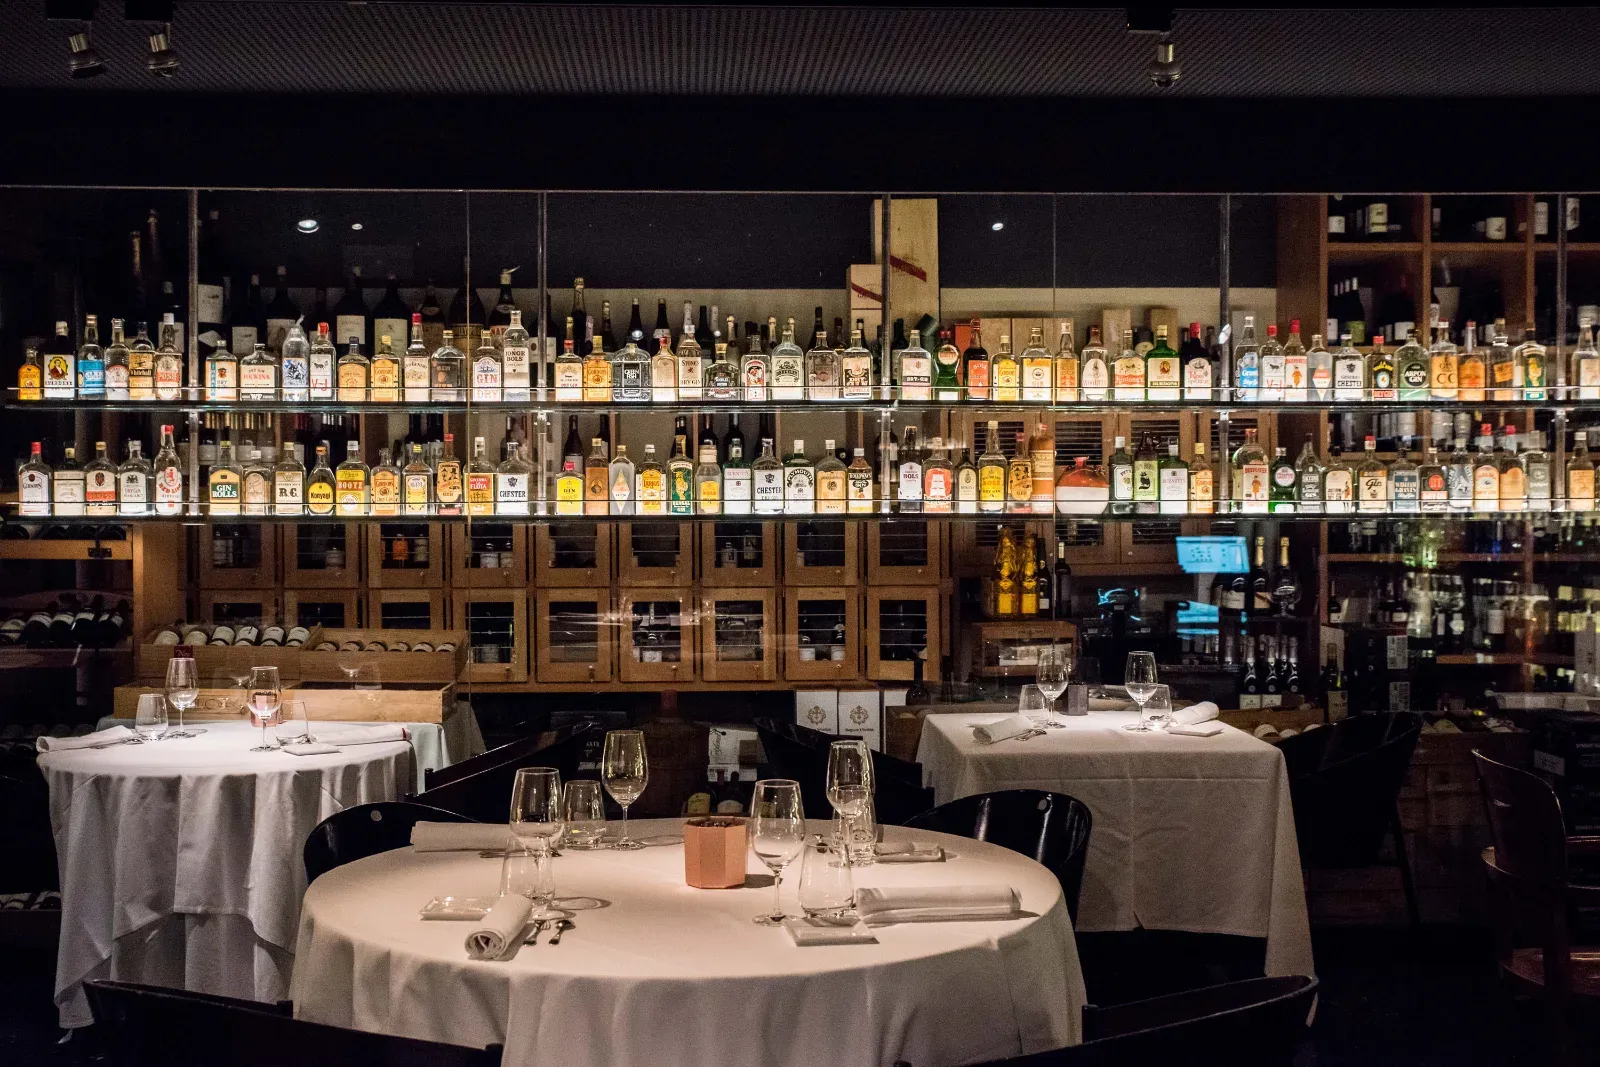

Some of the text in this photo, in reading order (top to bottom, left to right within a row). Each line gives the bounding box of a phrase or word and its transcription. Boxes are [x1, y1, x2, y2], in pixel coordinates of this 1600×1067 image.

[477, 374, 498, 384] GIN
[477, 389, 498, 399] DRY
[788, 468, 814, 481] PLYMOUTH
